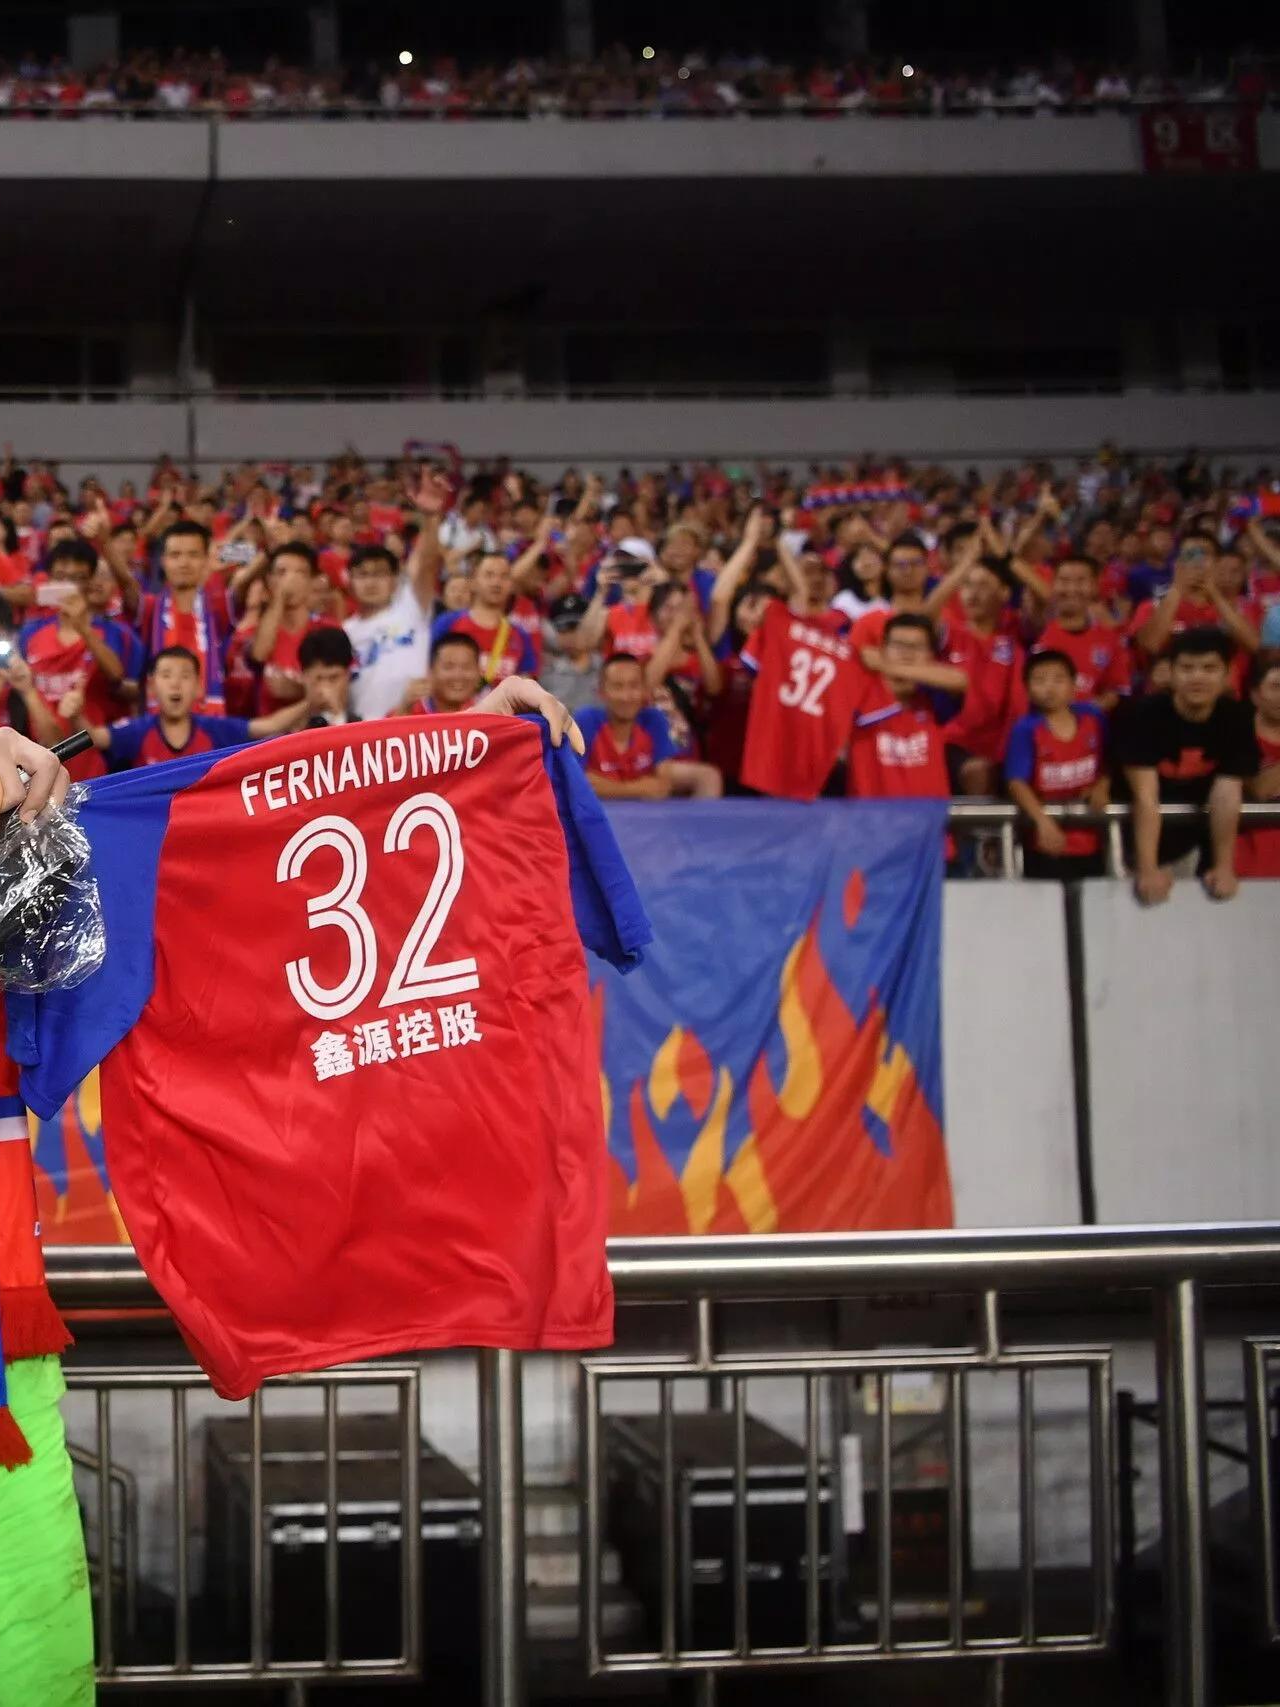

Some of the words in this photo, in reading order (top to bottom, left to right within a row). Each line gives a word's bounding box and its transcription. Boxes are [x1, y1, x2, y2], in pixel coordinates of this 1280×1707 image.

[778, 648, 837, 718] 32
[240, 728, 489, 817] FERNANDINHO
[276, 792, 480, 1021] 32
[310, 1002, 483, 1082] 鑫源控股
